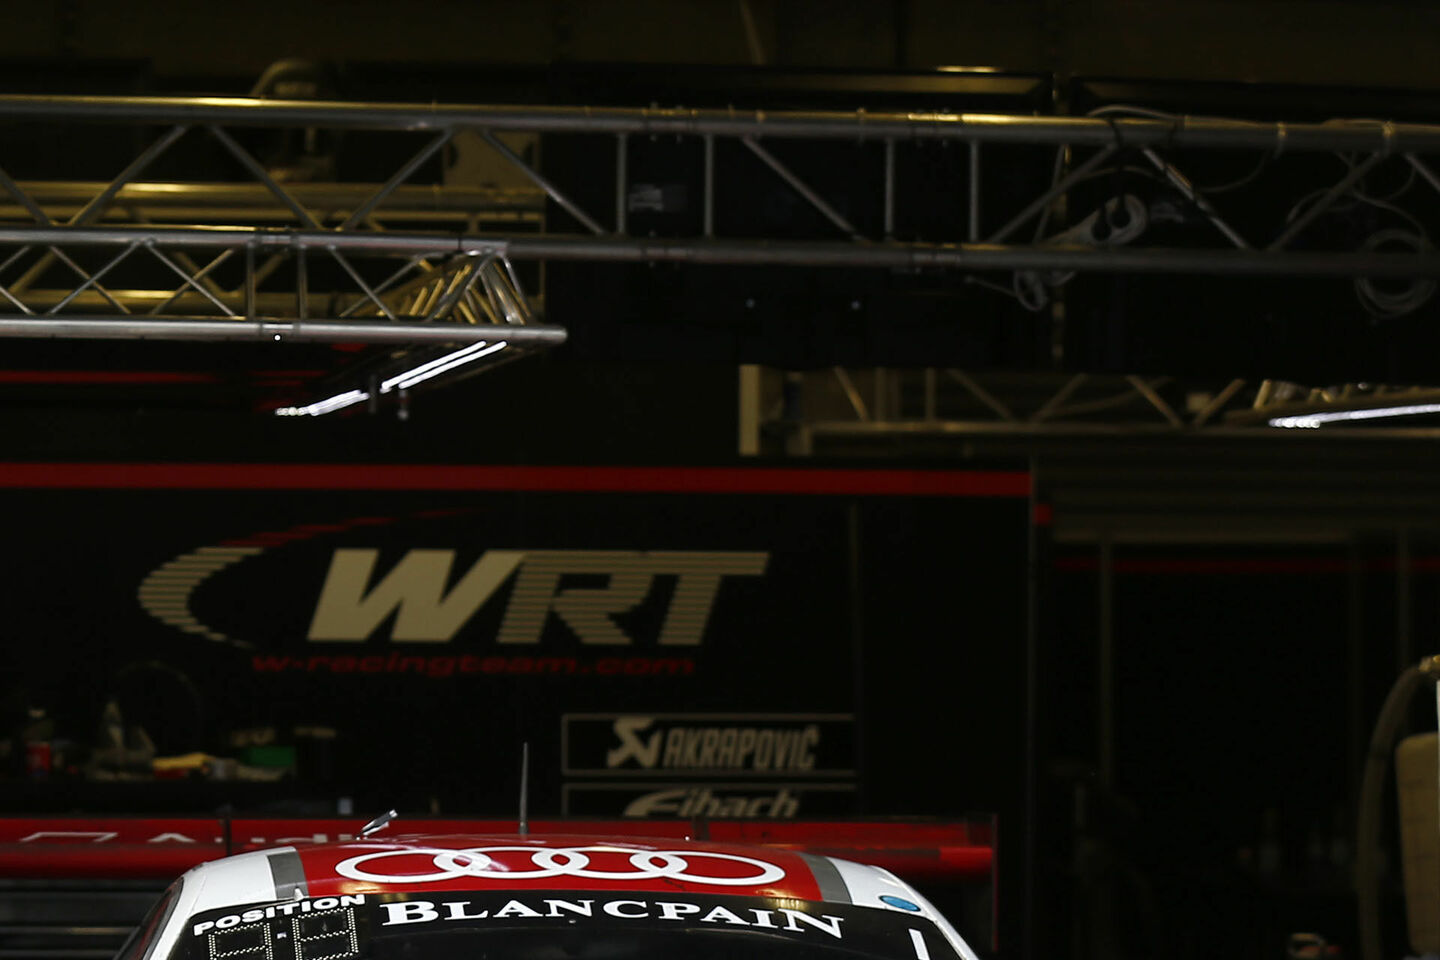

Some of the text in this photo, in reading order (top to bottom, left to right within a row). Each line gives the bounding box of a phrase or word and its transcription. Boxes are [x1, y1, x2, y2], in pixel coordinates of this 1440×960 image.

[306, 548, 770, 646] WRT
[250, 651, 697, 678] w-racingteam.com
[192, 894, 366, 937] POSITION
[378, 898, 845, 939] BLANCPAIN
